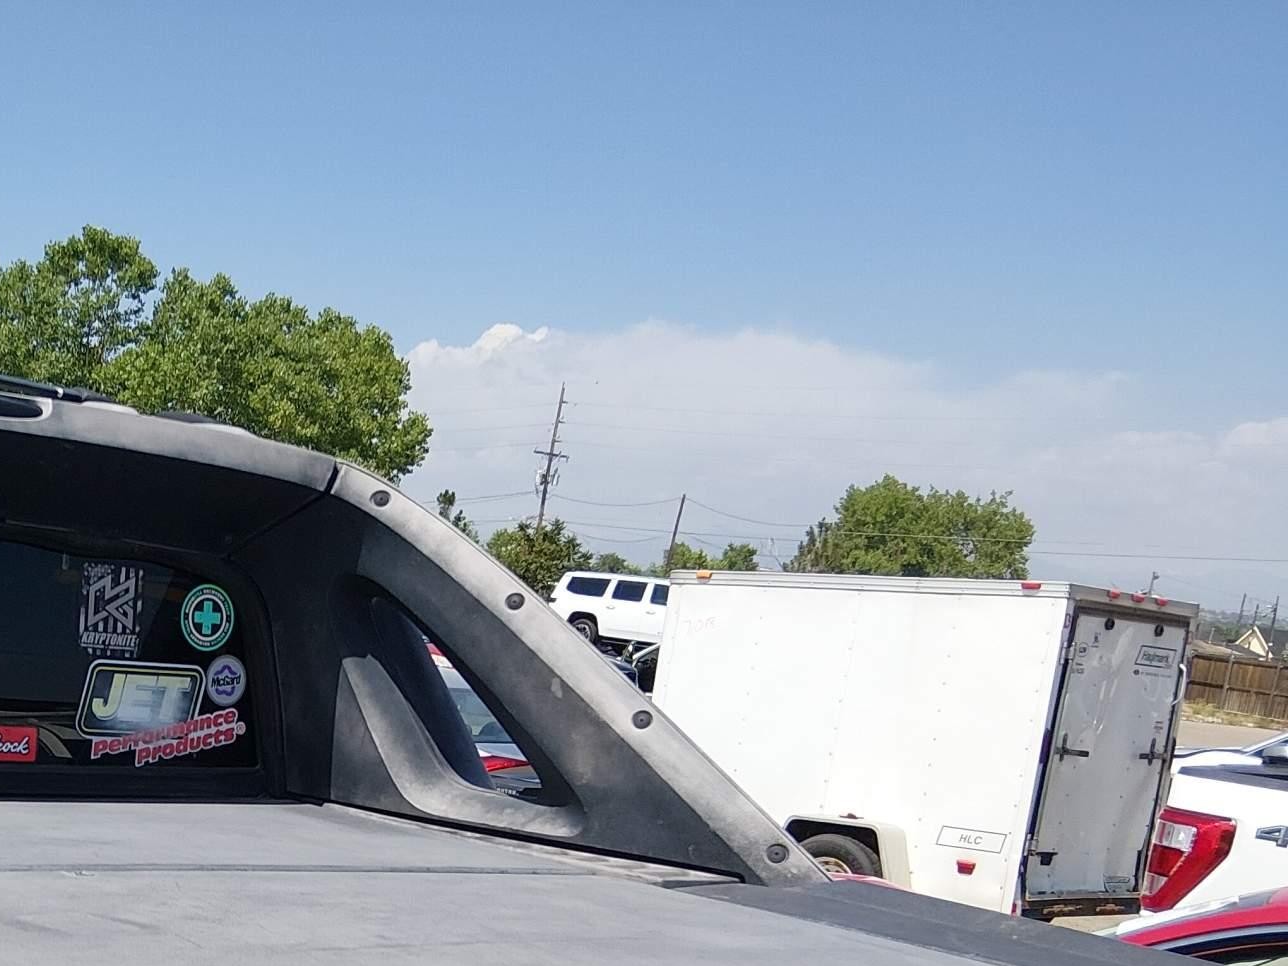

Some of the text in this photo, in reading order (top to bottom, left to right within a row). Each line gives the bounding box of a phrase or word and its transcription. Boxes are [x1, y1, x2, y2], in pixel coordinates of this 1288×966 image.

[81, 631, 138, 647] KRYPTONITE
[212, 673, 241, 688] McGard
[92, 673, 192, 721] JET
[959, 833, 984, 845] HLC
